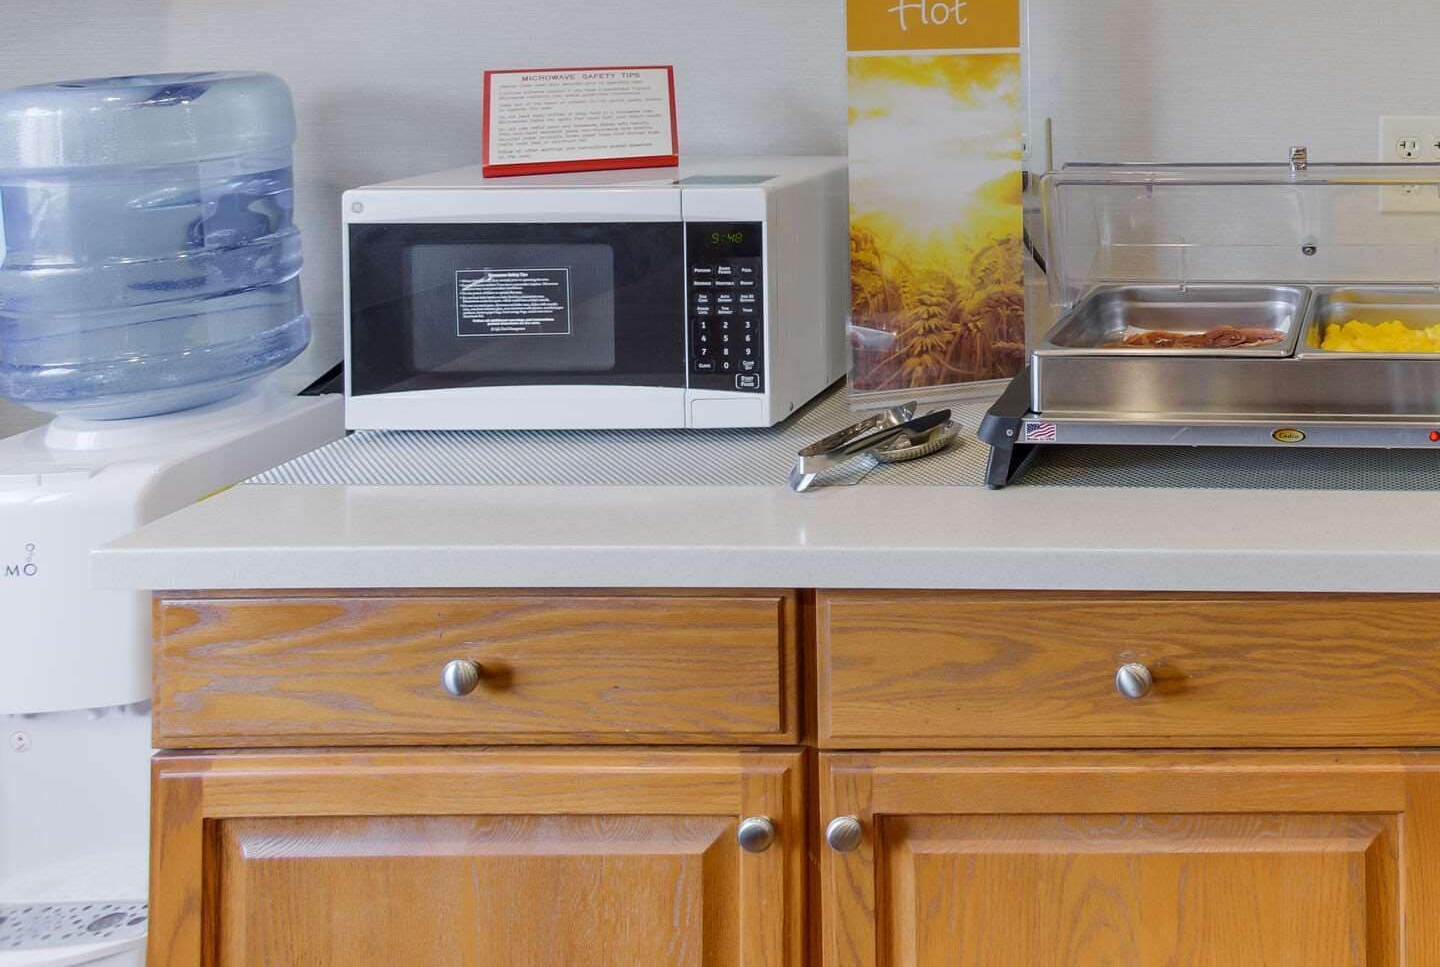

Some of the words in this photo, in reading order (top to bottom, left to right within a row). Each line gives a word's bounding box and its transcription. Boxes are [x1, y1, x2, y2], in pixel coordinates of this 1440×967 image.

[521, 73, 576, 82] MICROWAVE
[582, 72, 616, 81] SAFETY
[621, 71, 641, 79] TIPS
[711, 232, 743, 244] 9:48
[701, 321, 707, 329] 1
[723, 321, 729, 329] 2
[745, 321, 751, 329] 3
